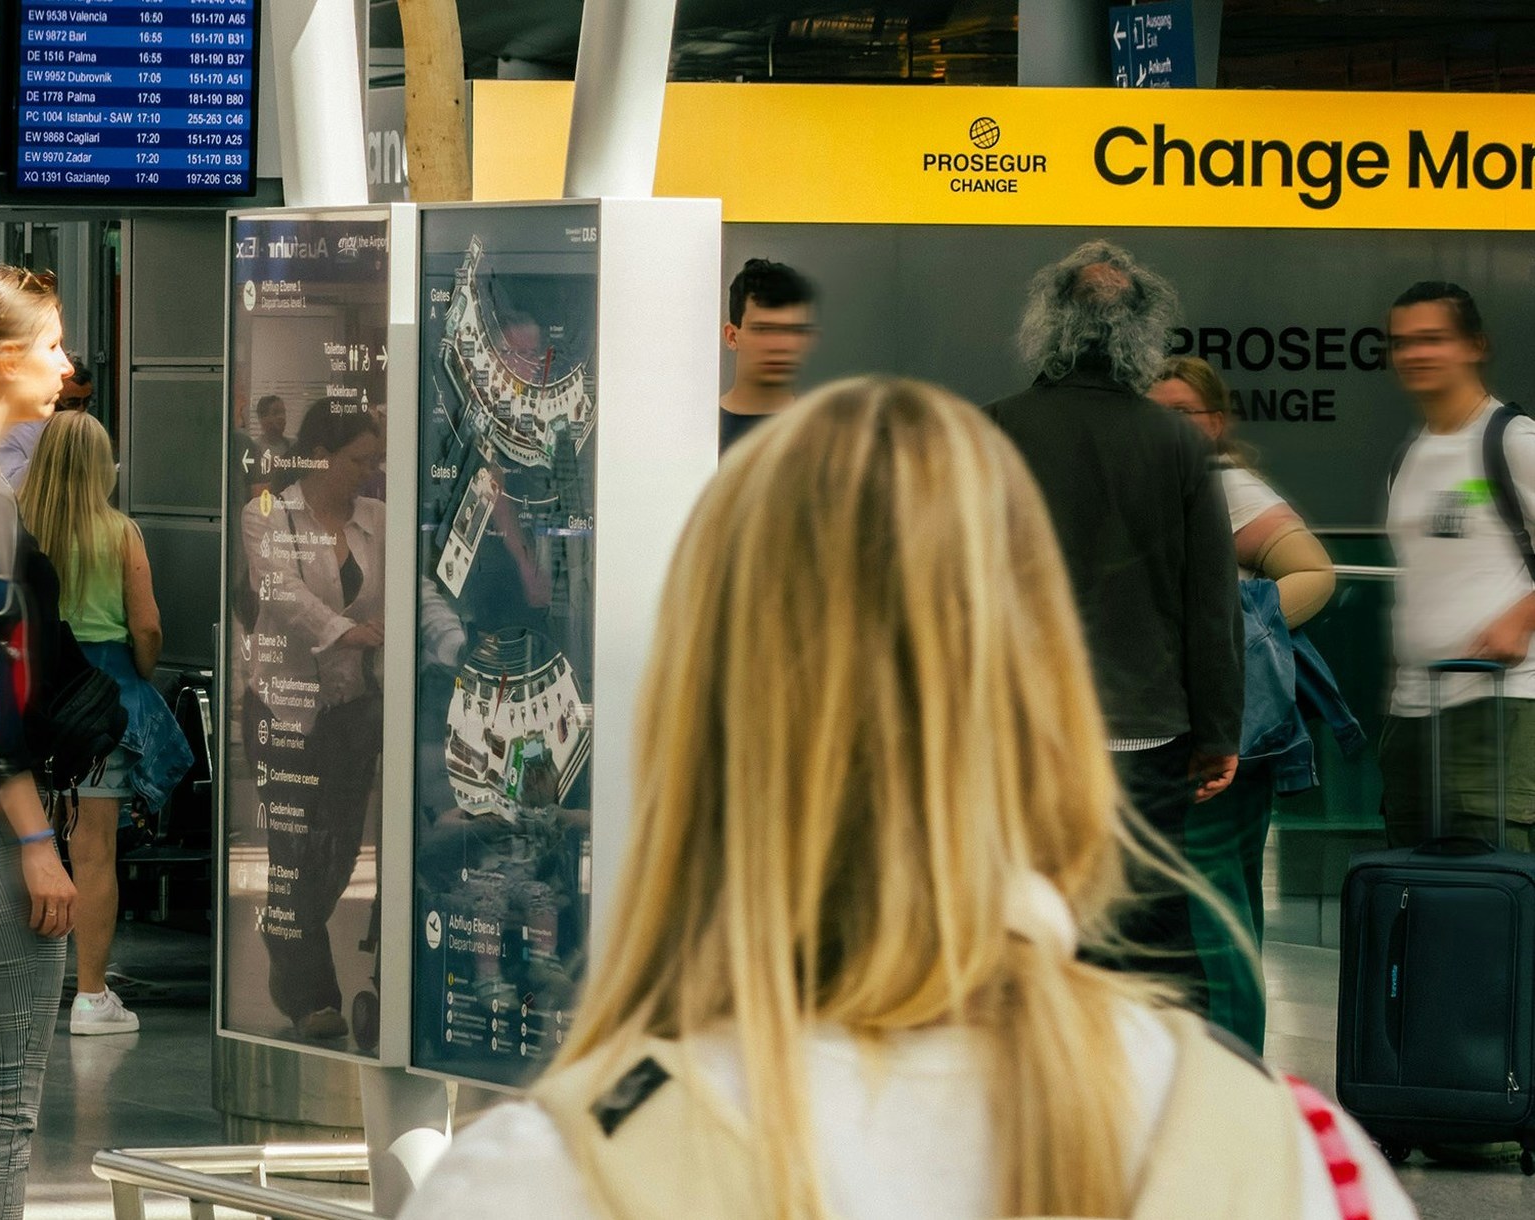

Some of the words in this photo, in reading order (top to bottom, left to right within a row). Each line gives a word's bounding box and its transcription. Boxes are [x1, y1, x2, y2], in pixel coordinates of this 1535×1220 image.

[28, 9, 45, 21] EW
[46, 10, 68, 22] 9538
[69, 11, 108, 22] Valencia
[140, 12, 163, 24] 16:50
[191, 13, 225, 25] 151-170
[228, 13, 246, 25] A65
[27, 70, 44, 81] EW
[44, 70, 66, 82] 9952
[68, 71, 112, 83] Dubrovnik
[138, 72, 162, 84] 17:05
[189, 73, 223, 85] 151-170
[226, 74, 243, 85] A51
[922, 152, 1047, 173] PROSEGUR
[1094, 123, 1389, 210] Change
[24, 171, 39, 182] XQ
[41, 171, 61, 183] 1391
[65, 171, 111, 185] Gaziantep
[136, 173, 159, 184] 17:40
[187, 173, 221, 185] 197-206
[224, 174, 242, 185] C36
[949, 179, 1018, 193] CHANGE
[581, 228, 597, 242] DUS
[280, 280, 297, 292] Ebene
[430, 288, 450, 303] Gates
[1165, 326, 1388, 371] PROSEG
[1229, 389, 1336, 422] ANGE
[273, 456, 291, 470] Shops
[297, 456, 330, 470] Restaurants
[430, 463, 451, 479] Gates
[451, 466, 458, 479] B
[568, 515, 587, 530] Gates
[588, 516, 594, 530] C
[258, 633, 276, 647] Ebene
[270, 768, 302, 785] Conference
[269, 801, 305, 817] Gedenkraum
[448, 914, 473, 935] Abflug
[473, 918, 495, 935] Ebene
[448, 935, 486, 954] Departures
